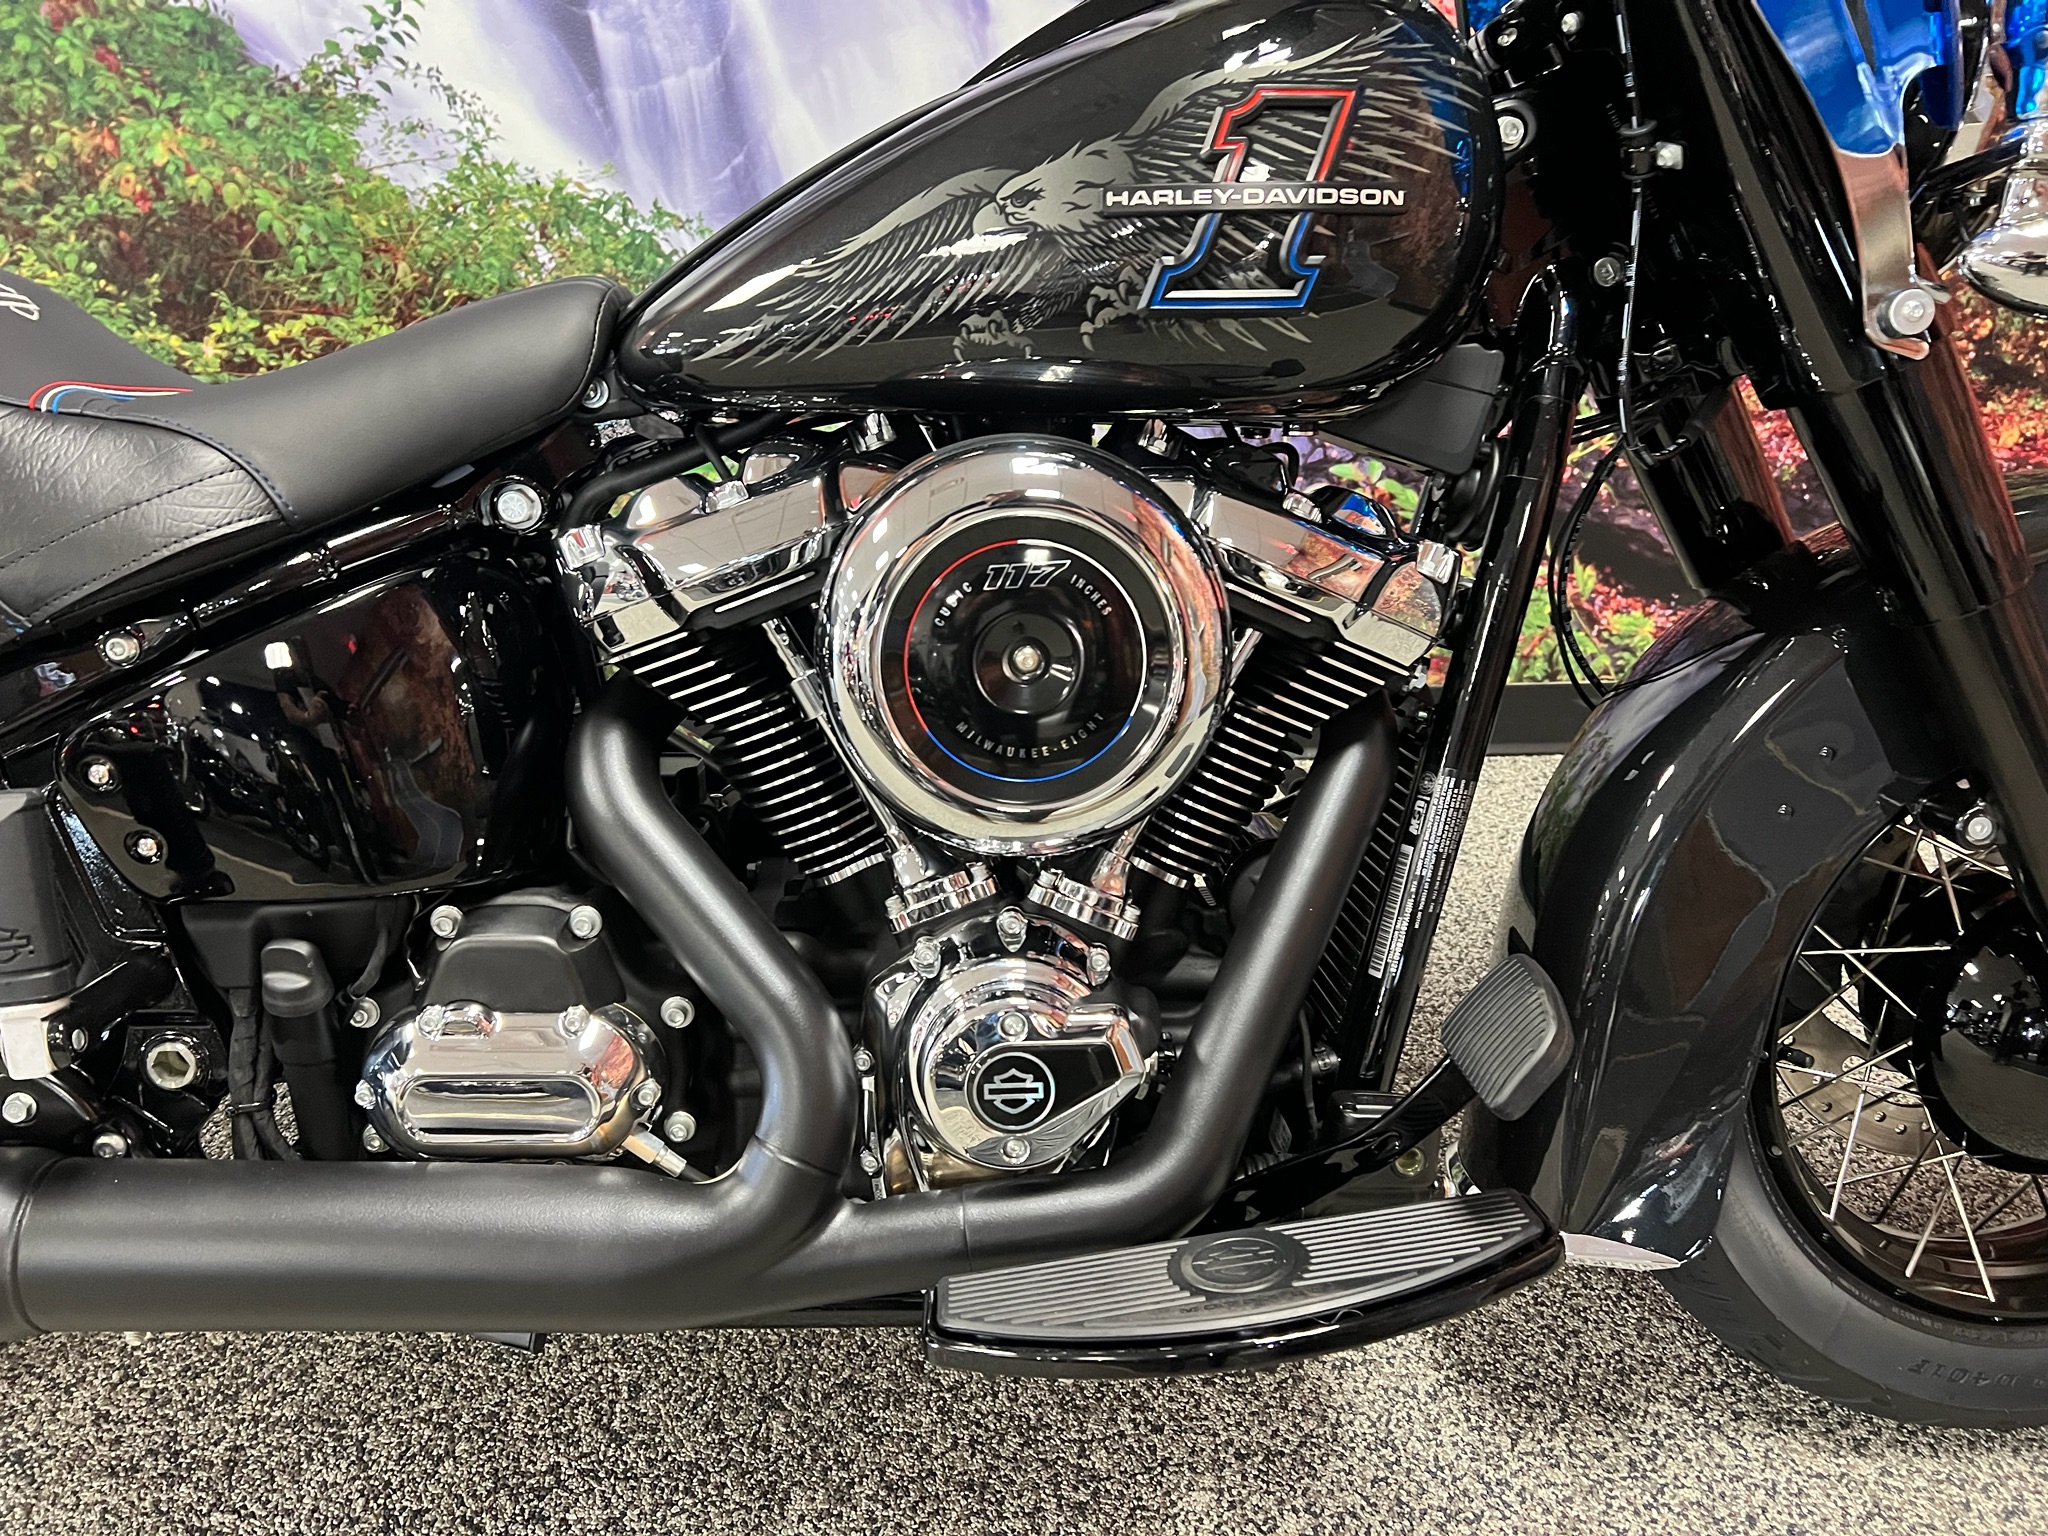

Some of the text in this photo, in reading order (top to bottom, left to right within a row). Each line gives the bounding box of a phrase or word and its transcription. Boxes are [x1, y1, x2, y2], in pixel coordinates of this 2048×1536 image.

[1106, 188, 1406, 207] HARLEY-DAVIDSON
[983, 559, 1072, 591] 117
[1069, 574, 1113, 617] INCHES
[955, 712, 1105, 759] MILWAUKEE-EIGHT
